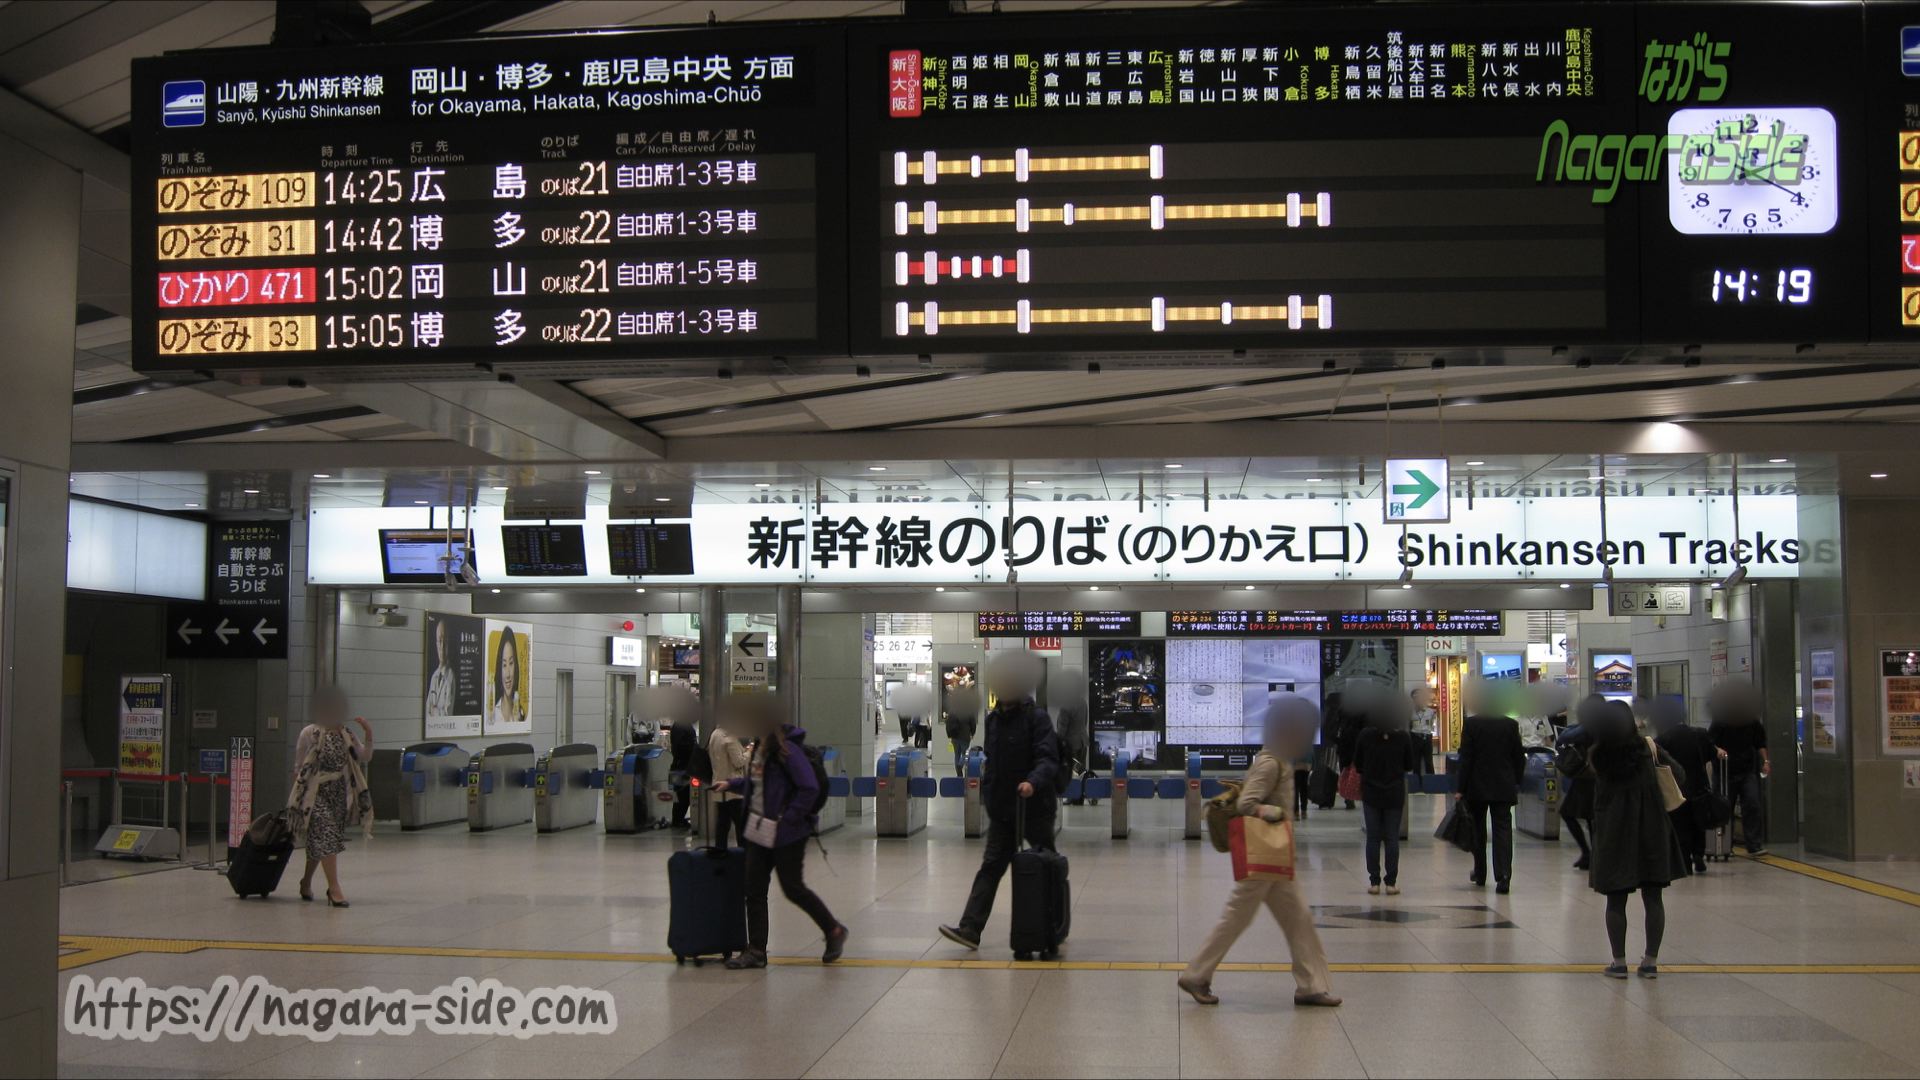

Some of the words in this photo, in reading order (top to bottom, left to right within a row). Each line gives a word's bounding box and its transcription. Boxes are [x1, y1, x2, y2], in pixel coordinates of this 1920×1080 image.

[411, 54, 732, 95] 岡山・博多・鹿児島中央
[743, 56, 795, 80] 方面
[952, 56, 967, 109] 西明石
[973, 55, 988, 109] 姫路
[994, 55, 1009, 109] 相生
[1014, 54, 1029, 108] 岡山
[1044, 53, 1059, 108] 新倉敷
[1065, 53, 1080, 106] 福山
[1086, 52, 1101, 106] 新尾道
[1107, 52, 1122, 105] 三原
[1127, 51, 1143, 105] 東広島
[1148, 50, 1164, 104] 広島
[1178, 50, 1194, 103] 新岩国
[1200, 49, 1215, 103] 徳山
[1220, 48, 1236, 103] 新山口
[1242, 48, 1258, 101] 厚狭
[1263, 47, 1279, 101] 新下関
[1284, 47, 1299, 101] 小倉
[1314, 46, 1330, 100] 博多
[1345, 45, 1361, 100] 新鳥栖
[1366, 45, 1382, 99] 久留米
[1387, 31, 1403, 99] 筑後船小屋
[1408, 44, 1425, 99] 新大牟田
[1430, 44, 1446, 99] 新玉名
[1451, 43, 1467, 98] 熊本
[1481, 43, 1497, 98] 新八代
[1503, 42, 1519, 97] 新水俣
[1524, 42, 1540, 97] 出水
[1546, 41, 1562, 97] 川内
[1565, 29, 1582, 96] 鹿児島中央
[217, 75, 384, 104] 山陽・九州新幹線
[411, 100, 433, 116] for
[440, 96, 526, 117] Okayama,
[534, 93, 601, 111] Hakata,
[607, 85, 762, 110] Kagoshima-Chūō
[892, 57, 907, 111] 新大阪
[923, 57, 938, 110] 新神戸
[217, 108, 258, 124] Sanyō,
[262, 106, 306, 123] Kyūshū
[310, 103, 381, 119] Shinkansen
[161, 152, 205, 165] 列車名
[321, 144, 358, 157] 時刻
[410, 141, 449, 153] 行先
[410, 153, 465, 164] Destination
[541, 135, 579, 148] のりば
[541, 149, 567, 159] Track
[616, 147, 636, 156] Cars
[161, 166, 184, 175] Train
[186, 165, 213, 174] Name
[321, 158, 368, 168] Departure
[371, 156, 394, 166] Time
[1684, 167, 1697, 181] 9
[1802, 166, 1815, 180] 3
[160, 178, 250, 209] のぞみ
[262, 177, 306, 204] 109
[324, 170, 402, 205] 14:25
[1696, 192, 1710, 208] 8
[1790, 192, 1804, 206] 4
[1719, 208, 1732, 223] 7
[1743, 212, 1757, 228] 6
[1767, 208, 1781, 223] 5
[160, 225, 250, 256] のぞみ
[268, 225, 295, 251] 31
[324, 218, 402, 253] 14:42
[160, 272, 249, 304] ひかり
[260, 272, 304, 300] 471
[324, 267, 402, 301] 15:02
[160, 321, 251, 352] のぞみ
[269, 321, 299, 347] 33
[324, 314, 403, 348] 15:05
[230, 547, 271, 560] 新幹線
[1398, 532, 1645, 567] Shinkansen
[1659, 531, 1799, 565] Tracks
[218, 563, 284, 577] 自動きっぷ
[229, 579, 267, 593] うりば
[980, 616, 1005, 624] さくら
[1024, 616, 1043, 624] 15:08
[1074, 616, 1083, 624] 20
[1217, 615, 1237, 623] 15:10
[1268, 615, 1277, 623] 25
[889, 641, 900, 651] 26
[904, 641, 916, 651] 27
[735, 662, 764, 673] 入口
